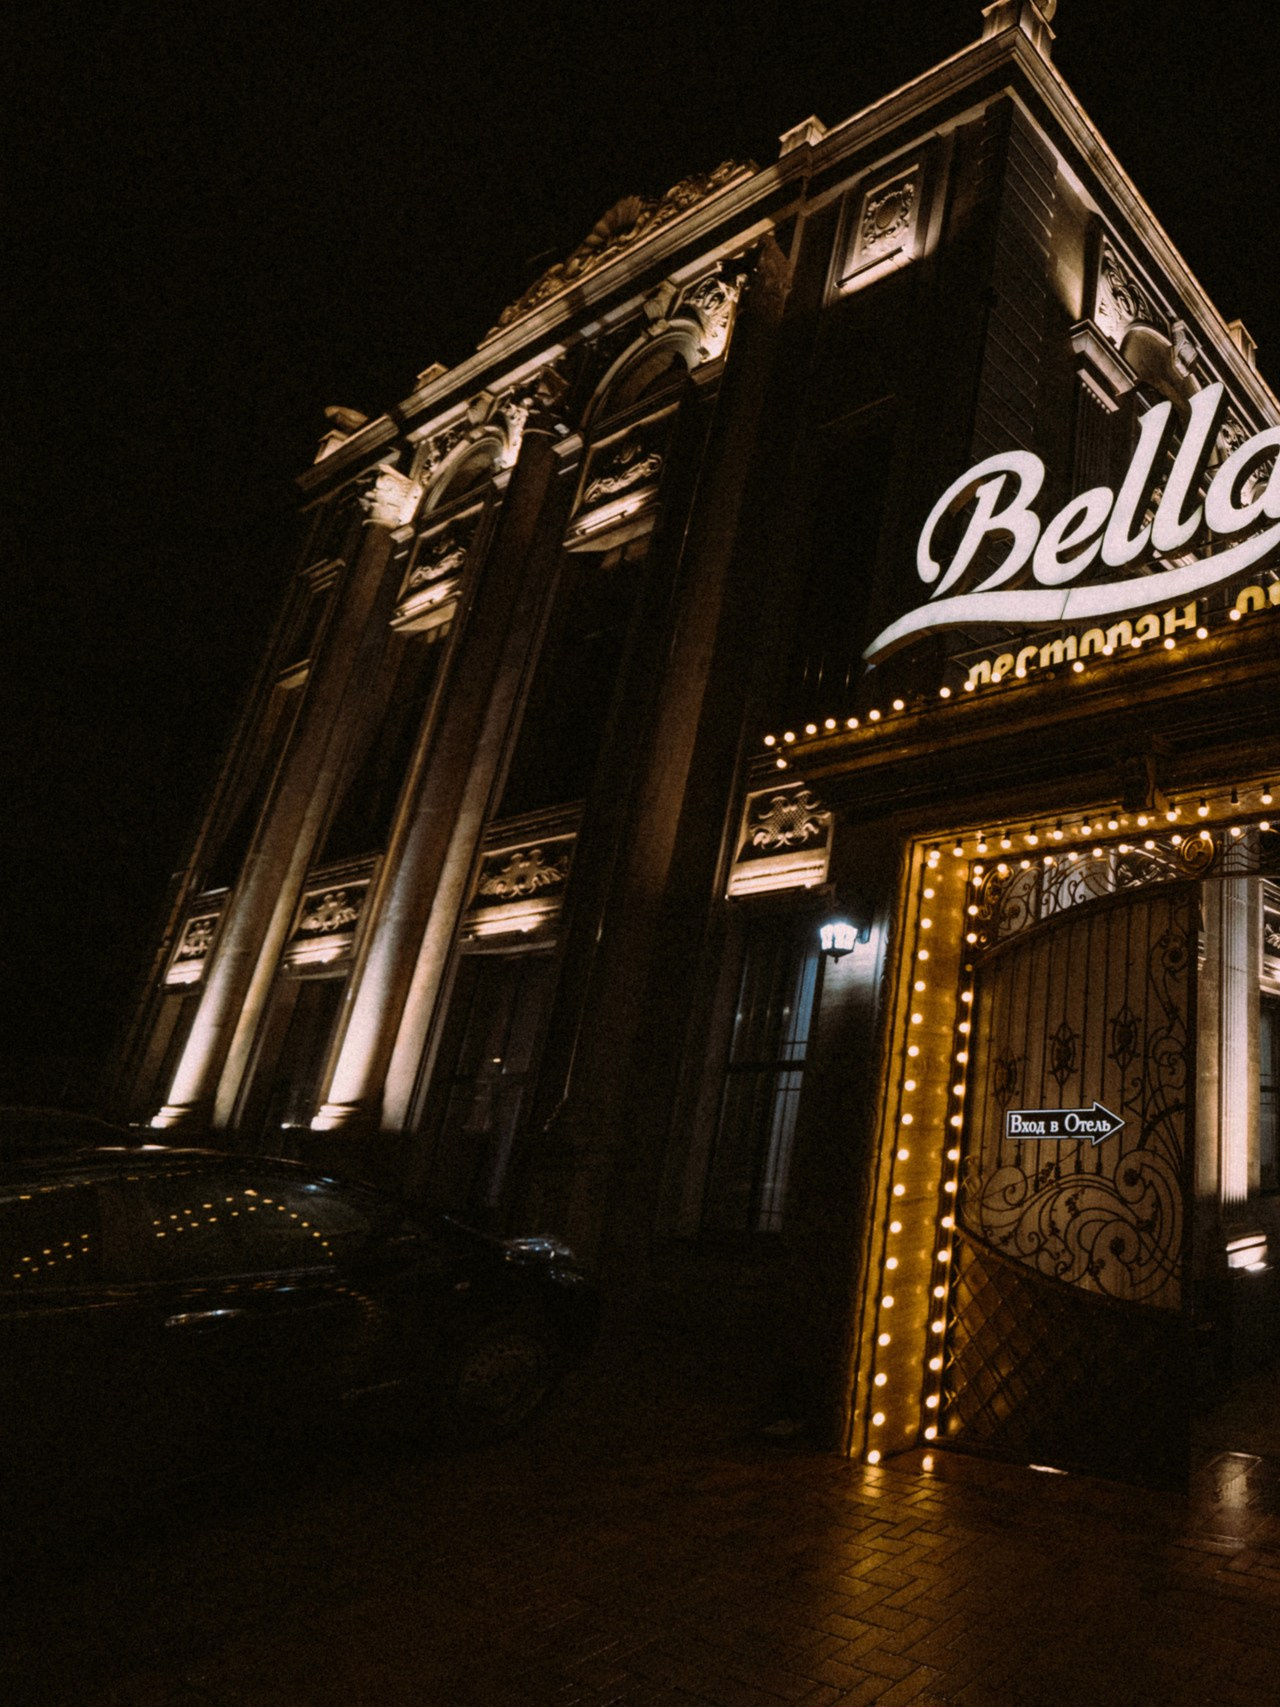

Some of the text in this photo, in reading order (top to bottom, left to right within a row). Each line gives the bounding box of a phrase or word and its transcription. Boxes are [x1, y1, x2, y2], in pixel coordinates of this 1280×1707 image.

[1010, 1113, 1111, 1134] Вход в Отель
